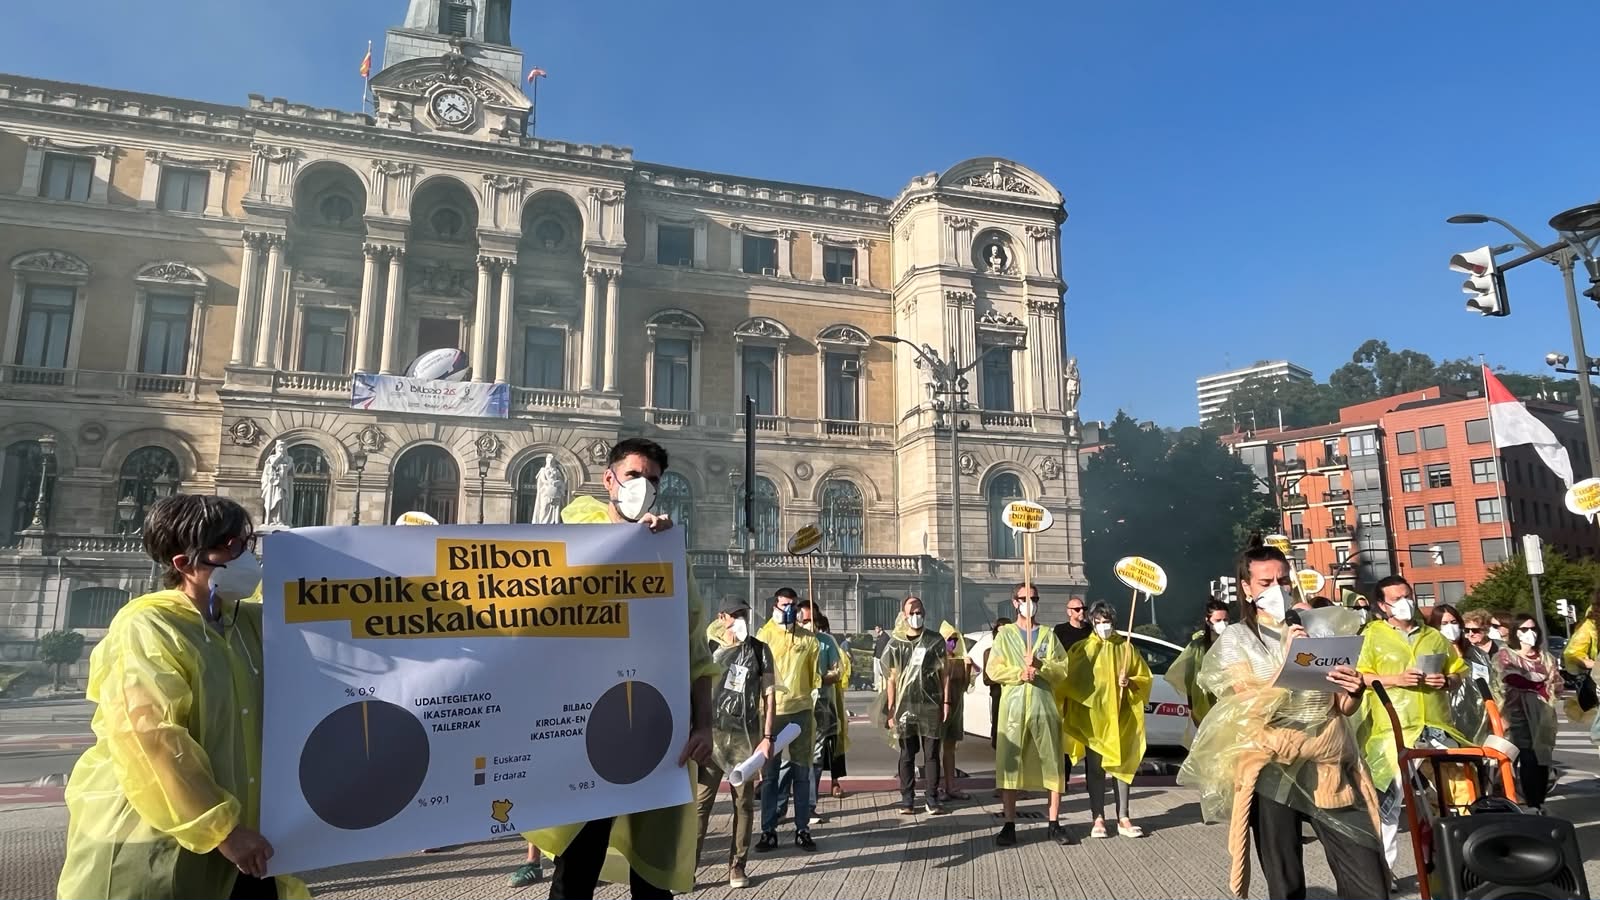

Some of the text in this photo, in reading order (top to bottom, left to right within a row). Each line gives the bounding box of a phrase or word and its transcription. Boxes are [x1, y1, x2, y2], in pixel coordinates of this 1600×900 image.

[1011, 504, 1044, 514] Euskaraz
[1011, 512, 1026, 520] bizi
[448, 543, 552, 570] Bilbon
[297, 569, 665, 605] kirolik eta ikastarorik ez
[364, 602, 622, 637] euskaldunontzat
[1314, 656, 1351, 667] GUKA
[617, 670, 624, 678] %
[344, 688, 355, 697] %
[414, 692, 492, 706] UDALTEGIETAKO
[423, 704, 502, 720] IKASTAROAK ETA
[563, 702, 593, 713] BILBAO
[431, 720, 481, 733] TAILERRAK
[535, 715, 587, 728] KIROLAK-EN
[530, 728, 584, 741] IKASTAROAK
[493, 753, 532, 765] Euskaraz
[493, 770, 527, 782] Erdaraz
[568, 783, 577, 792] %
[418, 798, 428, 808] %
[490, 822, 516, 835] GUKA
